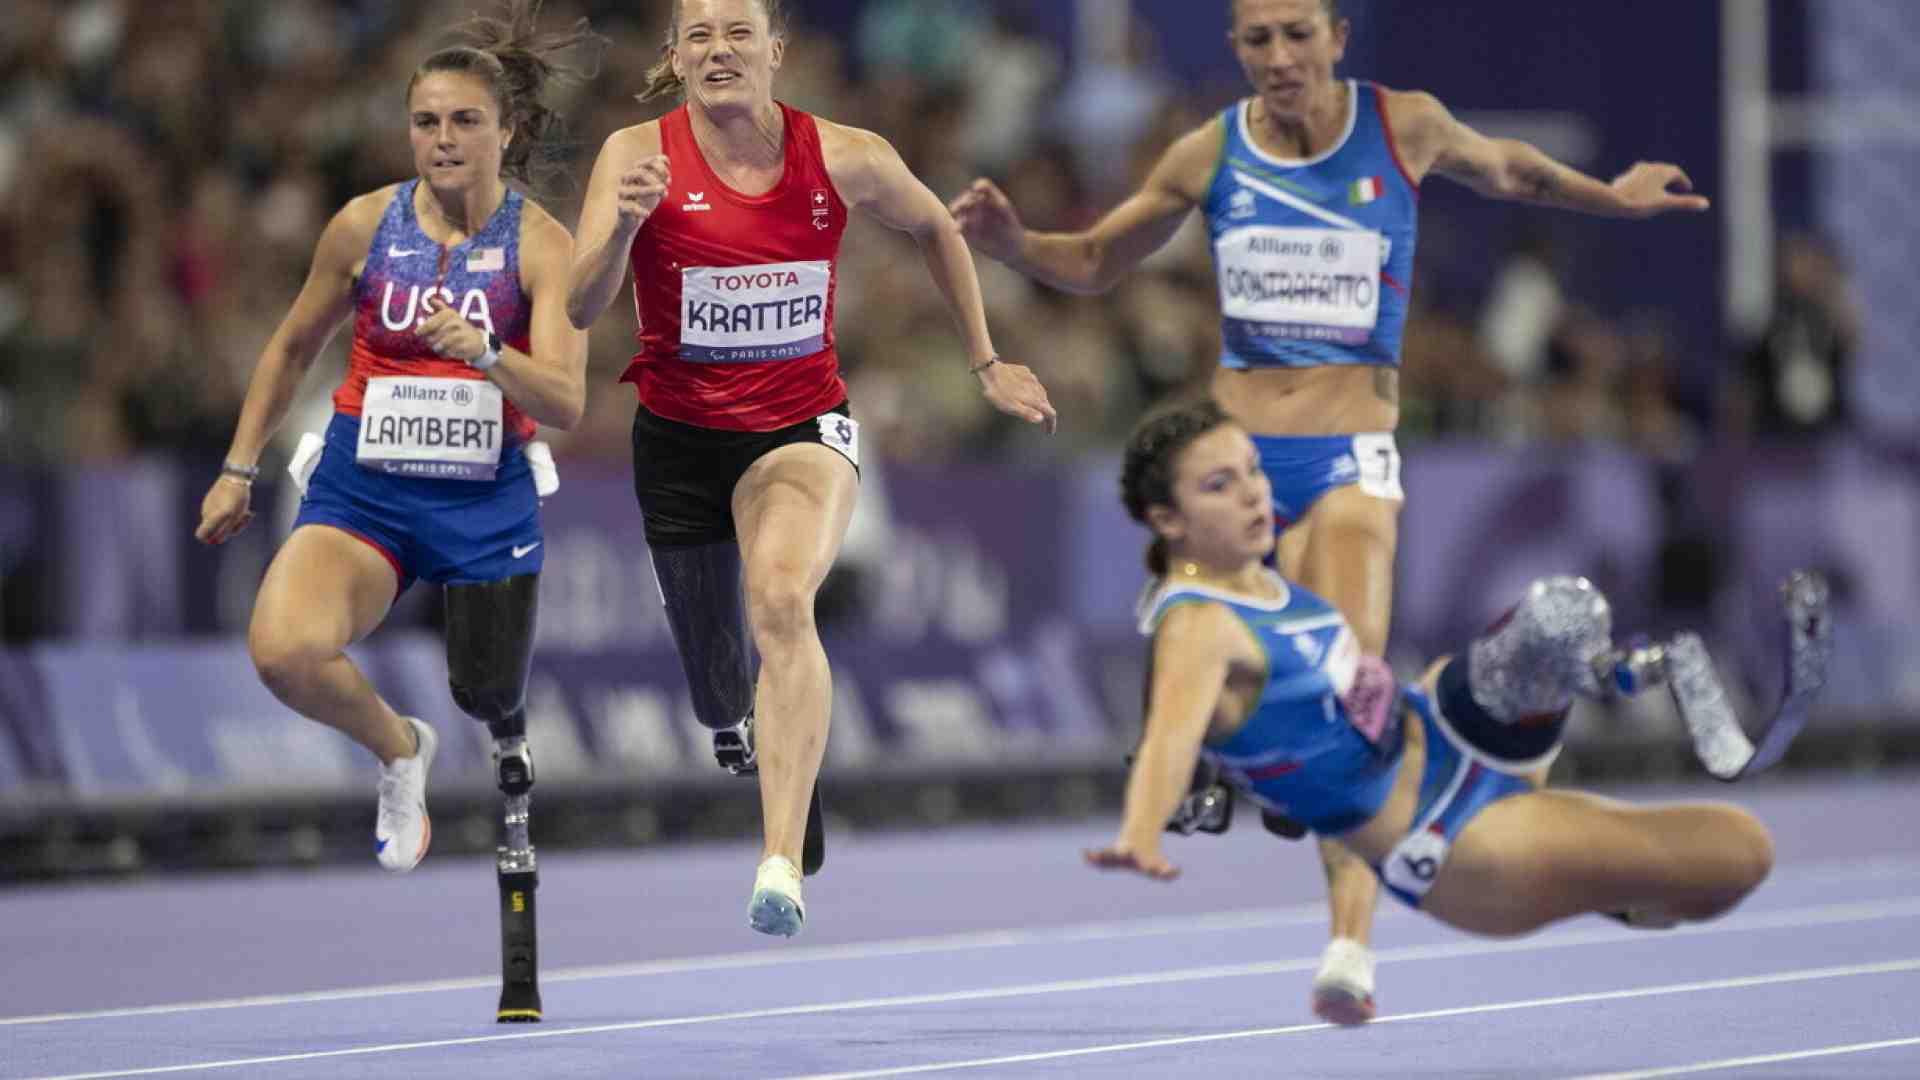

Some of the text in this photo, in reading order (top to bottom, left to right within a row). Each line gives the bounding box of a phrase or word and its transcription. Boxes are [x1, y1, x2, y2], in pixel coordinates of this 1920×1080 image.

[1249, 237, 1313, 255] Allianz
[712, 271, 799, 291] TOYOTA
[381, 281, 495, 335] USA
[688, 294, 822, 333] KRATTER
[731, 347, 800, 359] PARIS 2024
[392, 385, 447, 401] Allianz
[365, 416, 498, 450] LAMBERT
[402, 463, 437, 473] PARIS
[1377, 447, 1390, 481] 7
[1404, 854, 1436, 881] 6
